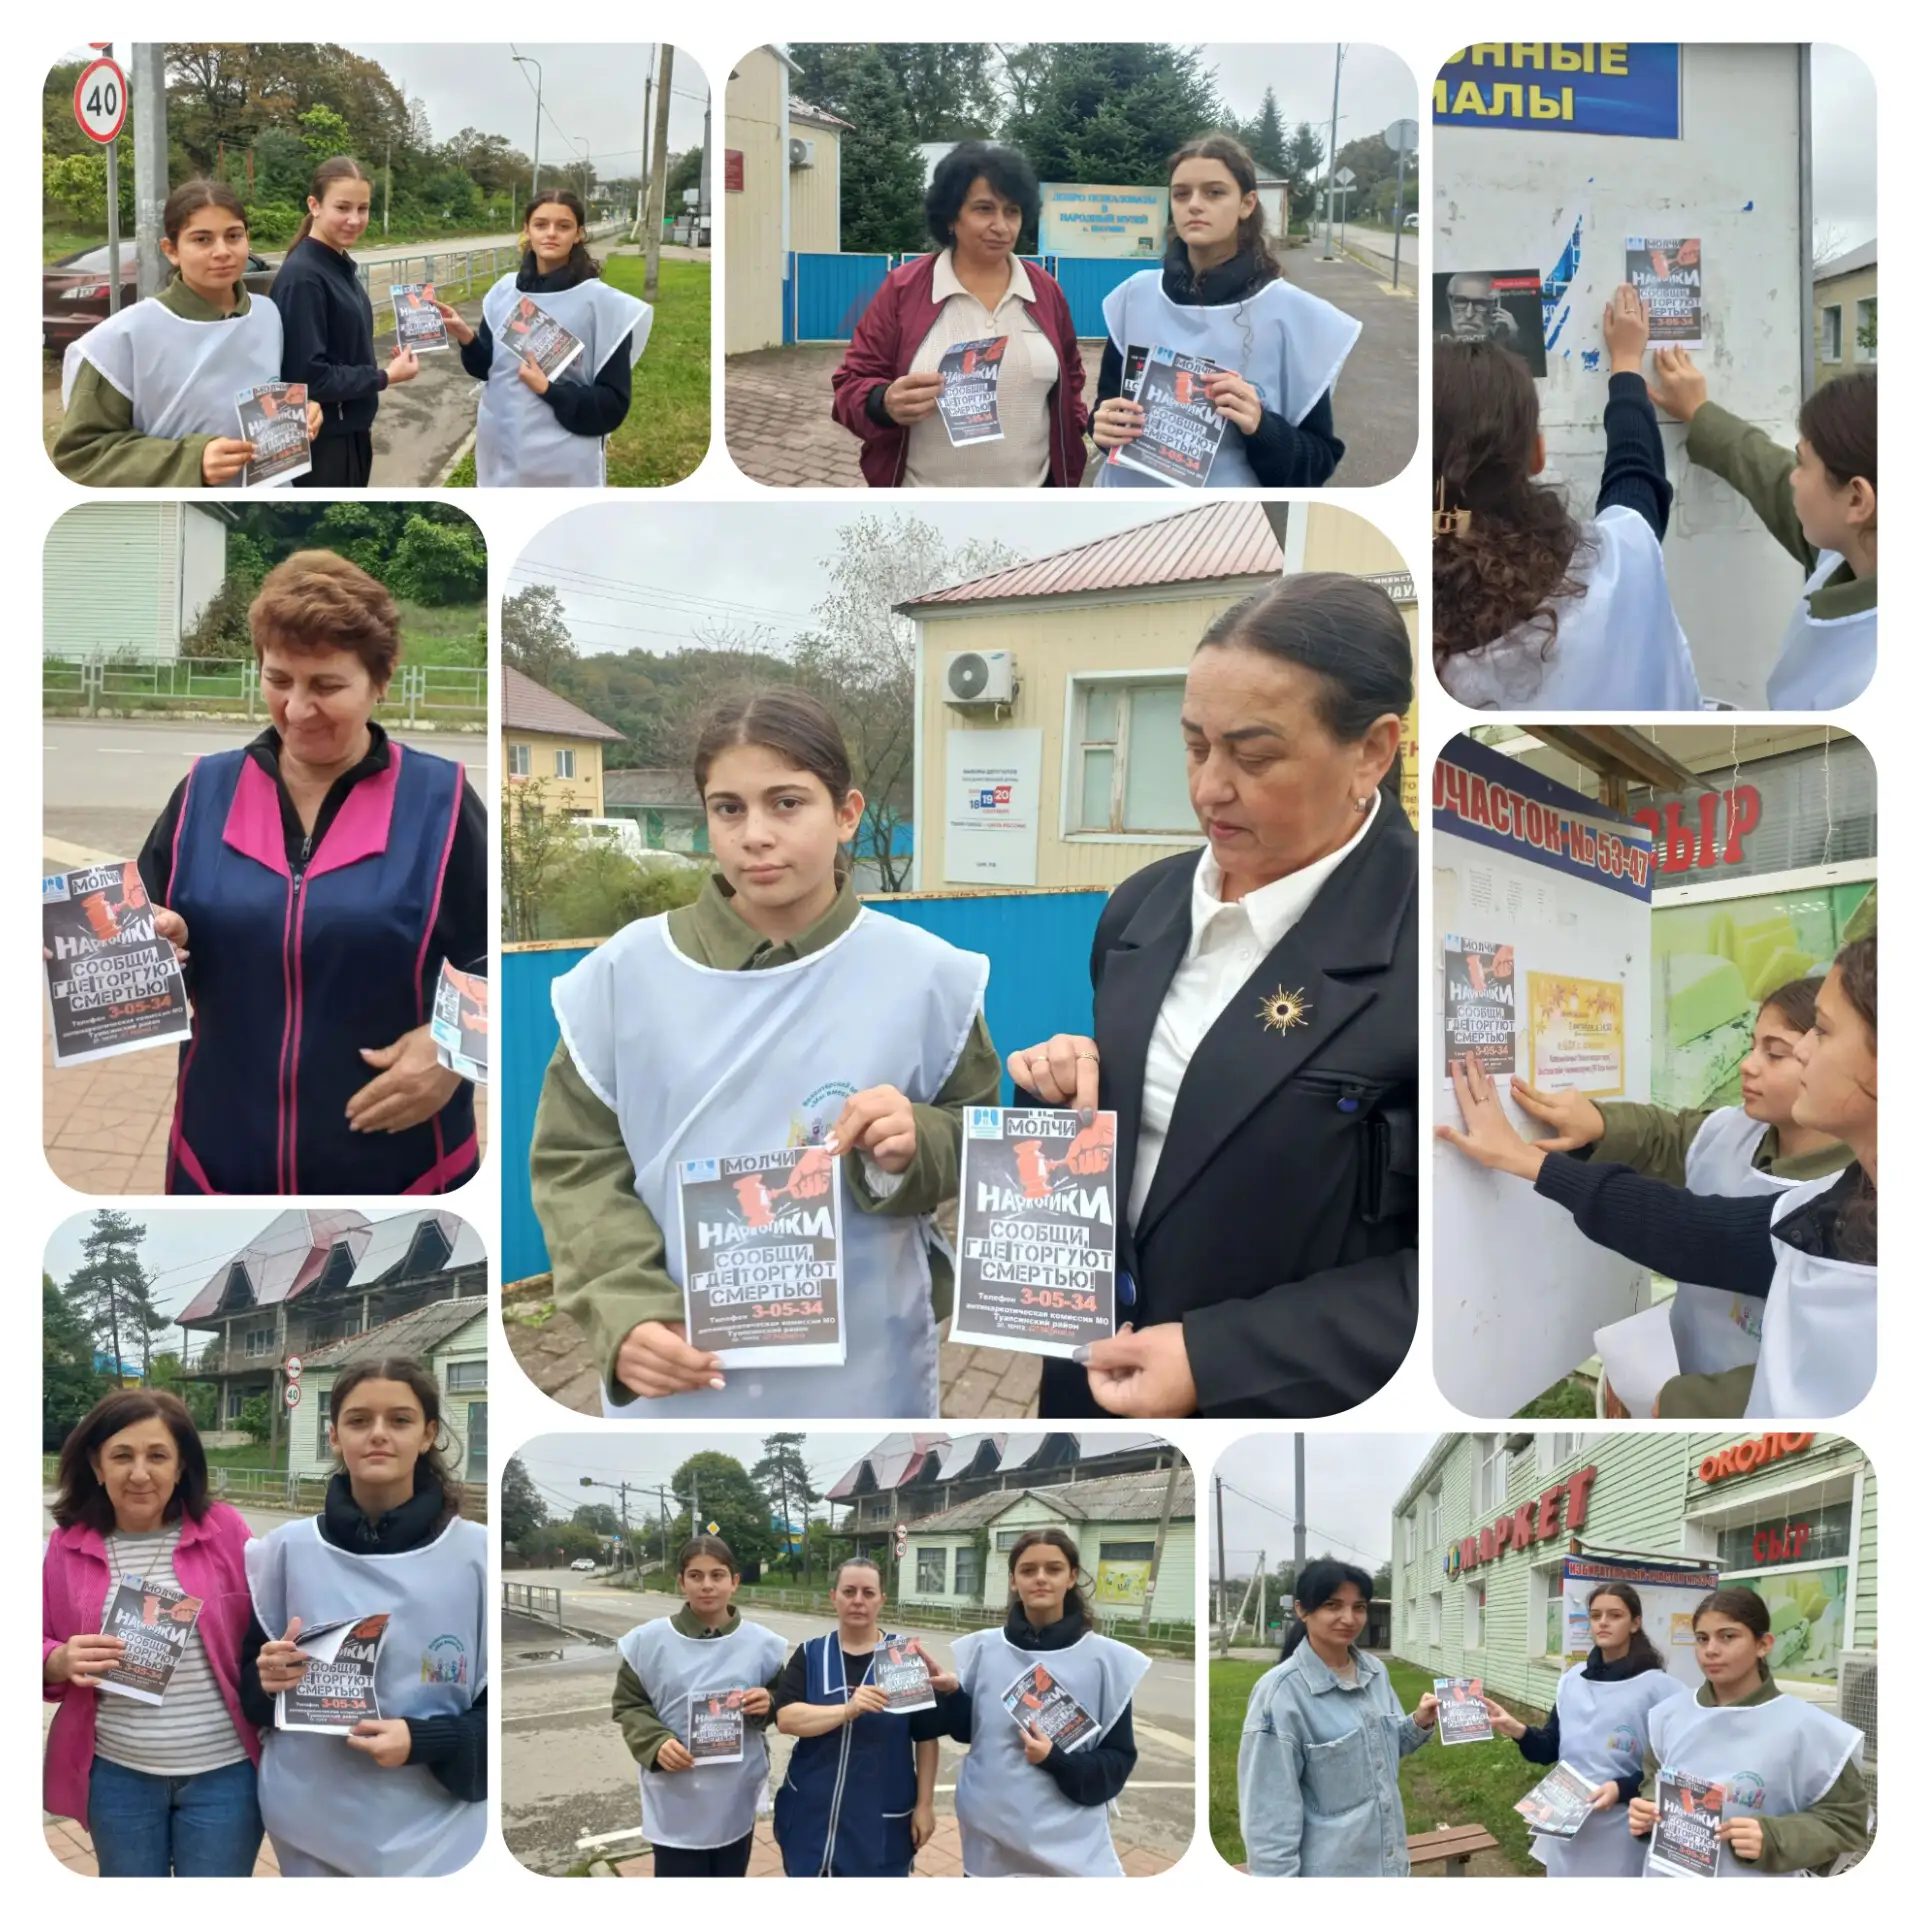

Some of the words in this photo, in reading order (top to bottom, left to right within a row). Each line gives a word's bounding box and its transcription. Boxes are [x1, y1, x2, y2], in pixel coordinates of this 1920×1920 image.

[86, 83, 117, 116] 40
[1152, 406, 1207, 436] СООБЩИ,
[1159, 421, 1216, 453] ТОРГУЮТ
[982, 794, 993, 804] 19
[995, 789, 1009, 800] 20
[1433, 759, 1562, 855] УЧАСТОК
[1569, 821, 1595, 866] №
[1598, 831, 1649, 888] 53-47
[73, 871, 121, 895] МОЛЧИ
[1463, 940, 1495, 953] МОЛЧИ
[73, 949, 159, 977] СООБЩИ,
[53, 980, 90, 997] ГДЕ
[99, 960, 178, 990] ТОРГУЮТ
[71, 978, 169, 1011] СМЕРТЬЮ!
[108, 995, 173, 1018] 3-05-34
[1458, 1006, 1505, 1019] СООБЩИ,
[1455, 1032, 1508, 1043] СМЕРТЬЮ!
[1470, 1020, 1514, 1032] ТОРГУЮТ
[1475, 1045, 1508, 1056] 3-05-34
[1008, 1119, 1075, 1136] МОЛЧИ
[726, 1151, 795, 1174] МОЛЧИ
[977, 1180, 1113, 1226] НАРКОТИКИ
[991, 1221, 1088, 1247] СООБЩИ,
[716, 1245, 813, 1268] СООБЩИ,
[965, 1239, 1006, 1260] ГДЕ
[1013, 1243, 1112, 1270] ТОРГУЮТ
[692, 1270, 733, 1290] ГДЕ
[742, 1262, 835, 1285] ТОРГУЮТ
[982, 1262, 1096, 1290] СМЕРТЬЮ!
[711, 1281, 821, 1304] СМЕРТЬЮ!
[978, 1292, 1016, 1304] Телефон
[1020, 1287, 1098, 1312] 3-05-34
[752, 1300, 823, 1318] 3-05-34
[1052, 1320, 1079, 1330] район
[1095, 1317, 1109, 1325] МО
[1460, 1465, 1598, 1571] МАРКЕТ
[1753, 1522, 1811, 1563] СЫР
[144, 1582, 181, 1601] МОЛЧИ
[124, 1653, 166, 1671] ЕРТЬЮ!
[127, 1643, 178, 1666] ТОРГУЮТ
[296, 1684, 364, 1697] СМЕРТЬЮ!
[314, 1674, 373, 1686] ТОРГУЮТ
[321, 1698, 367, 1709] 3-05-34
